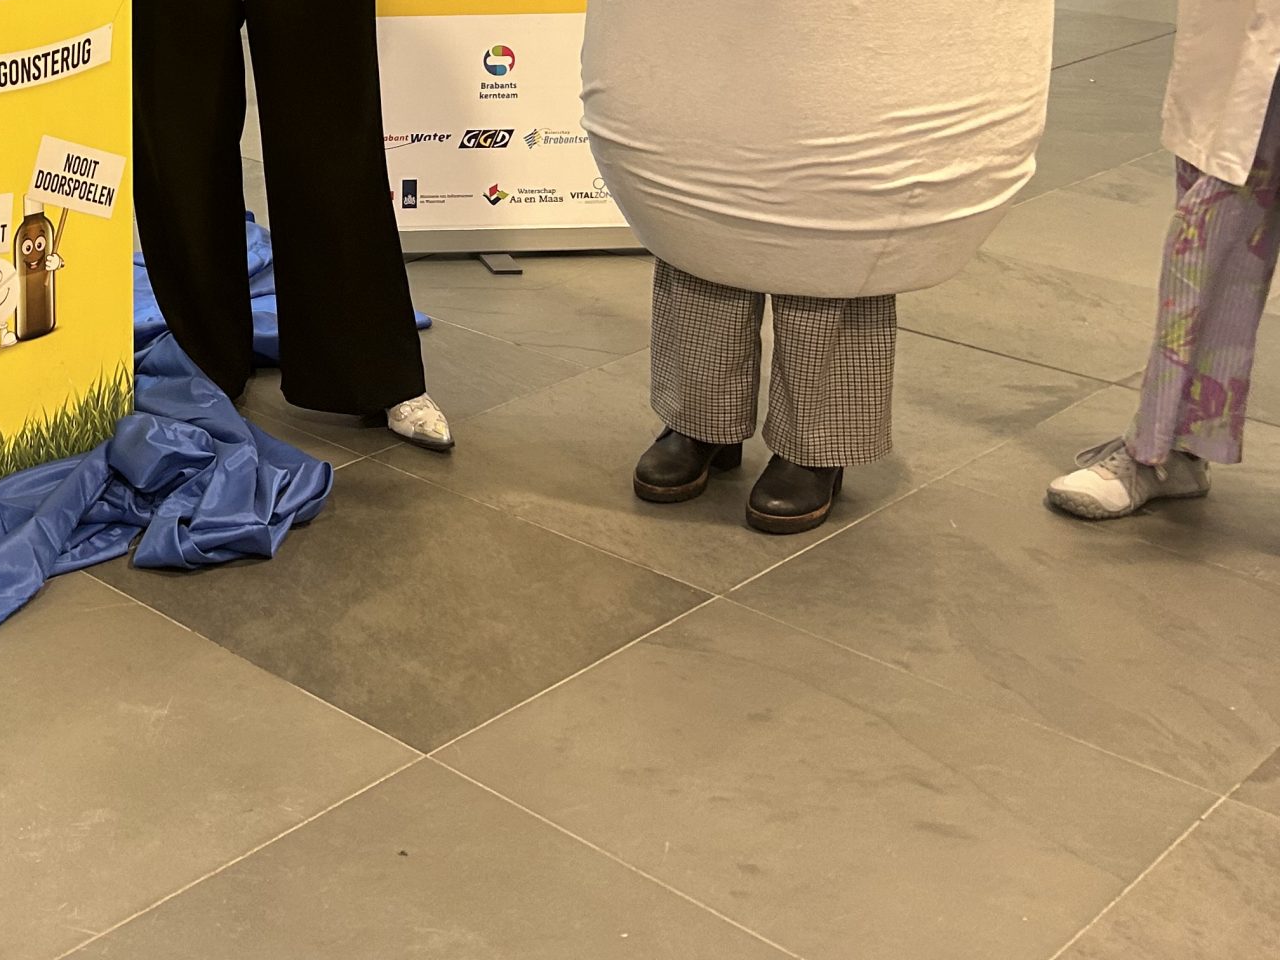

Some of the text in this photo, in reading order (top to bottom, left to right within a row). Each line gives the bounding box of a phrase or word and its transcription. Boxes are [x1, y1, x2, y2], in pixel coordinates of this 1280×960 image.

[480, 82, 517, 90] Brabants
[479, 92, 518, 100] kernteam
[410, 133, 451, 143] Water
[462, 130, 510, 147] GGD
[63, 152, 100, 180] NOOIT
[34, 169, 115, 208] DOORSPOELEN
[517, 187, 557, 195] Waterschap
[509, 195, 524, 203] Aa
[538, 195, 564, 203] Maas
